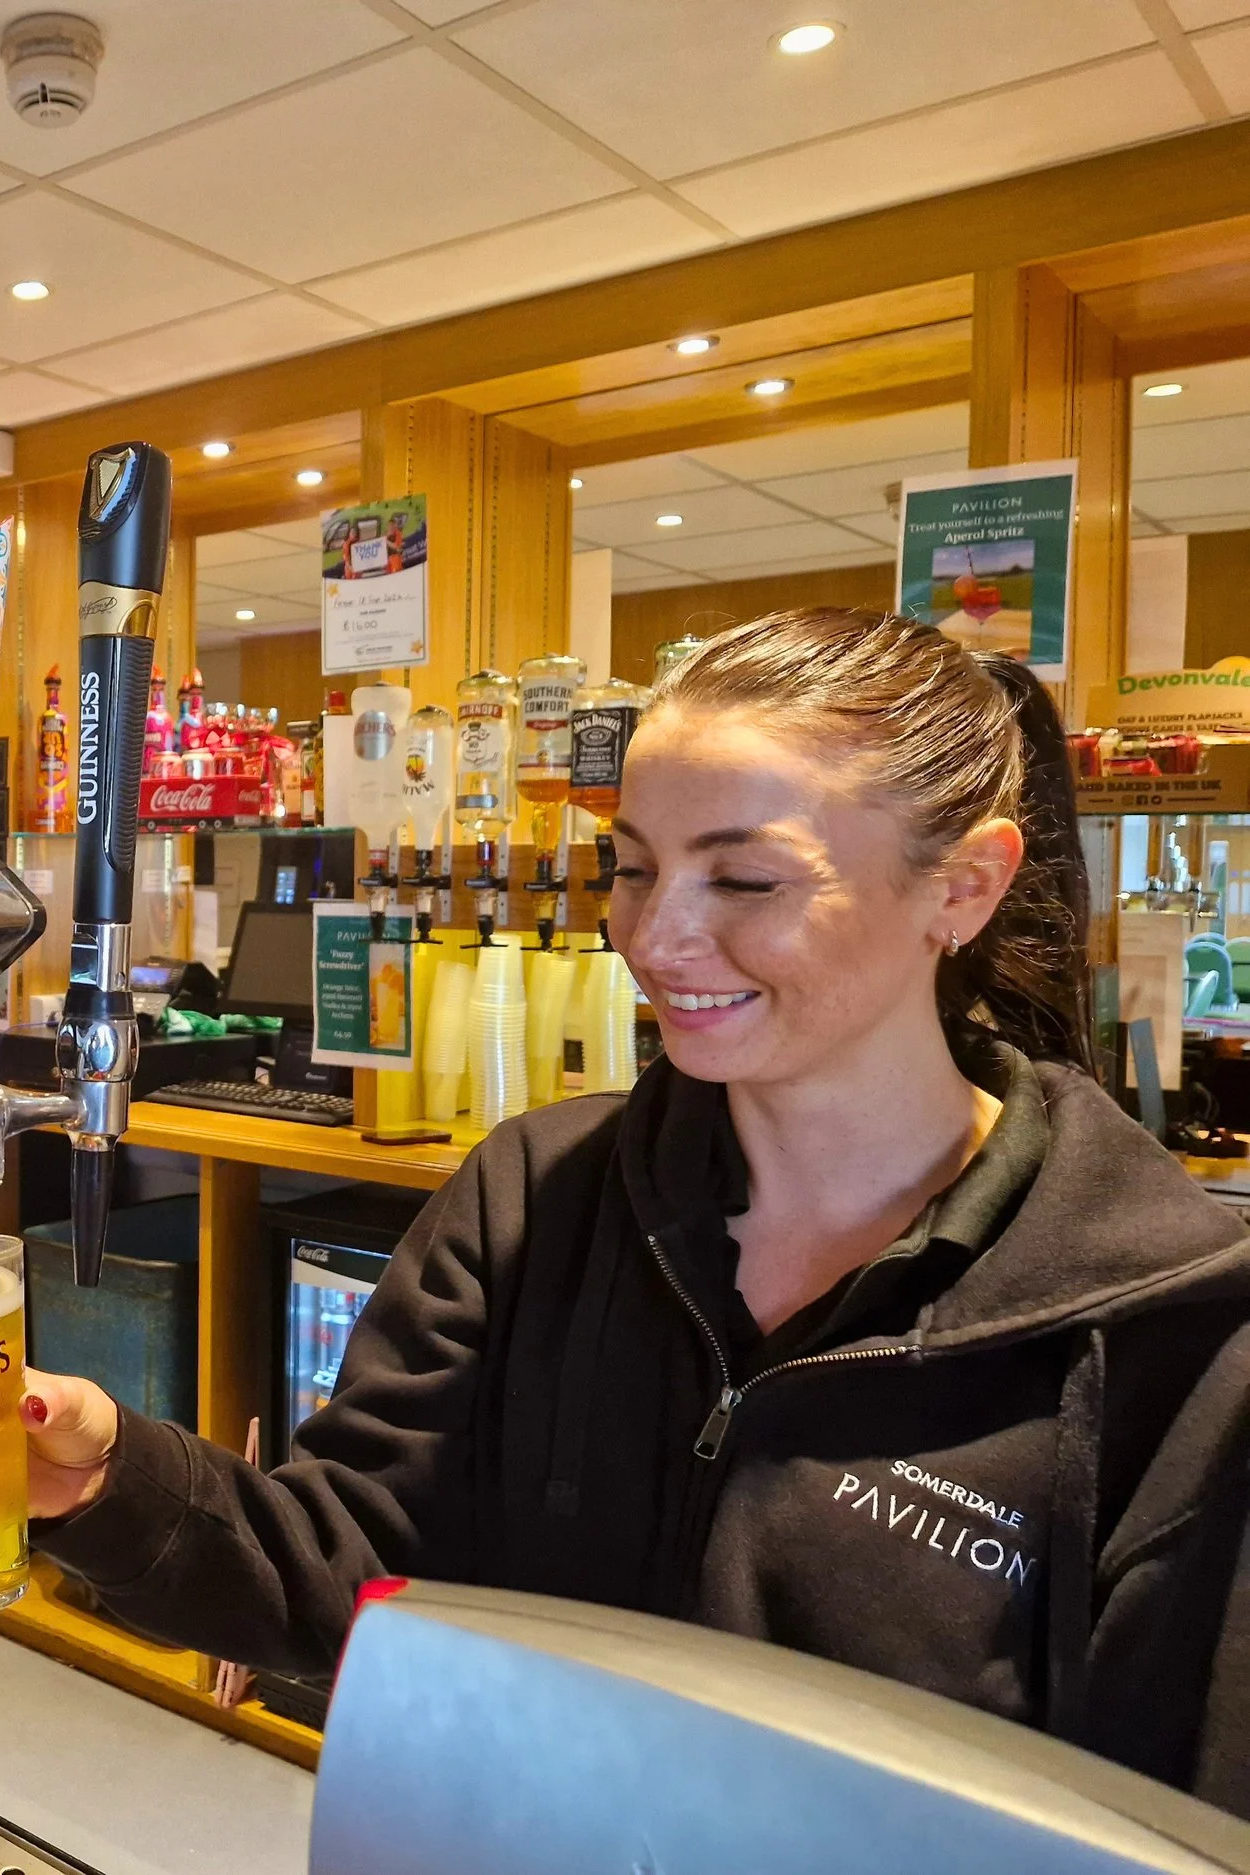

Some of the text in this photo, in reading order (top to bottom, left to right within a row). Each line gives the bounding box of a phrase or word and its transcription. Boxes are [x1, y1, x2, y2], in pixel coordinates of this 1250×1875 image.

[952, 497, 1022, 514] PAVILION
[908, 522, 936, 533] Treat
[938, 518, 981, 531] yourself
[984, 515, 995, 525] to
[1006, 509, 1064, 522] refreshing
[944, 526, 1025, 544] Aperol Spritz
[359, 550, 378, 561] YOU
[1117, 668, 1250, 695] Devonvale
[523, 686, 573, 700] SOUTHERN
[524, 701, 570, 713] COMFORT
[573, 715, 593, 732] JACK
[77, 671, 100, 825] GUINNESS
[1173, 780, 1199, 791] THE
[1201, 779, 1222, 791] UK
[890, 1459, 1024, 1529] SOMERDALE
[832, 1472, 1037, 1587] PAVILION
